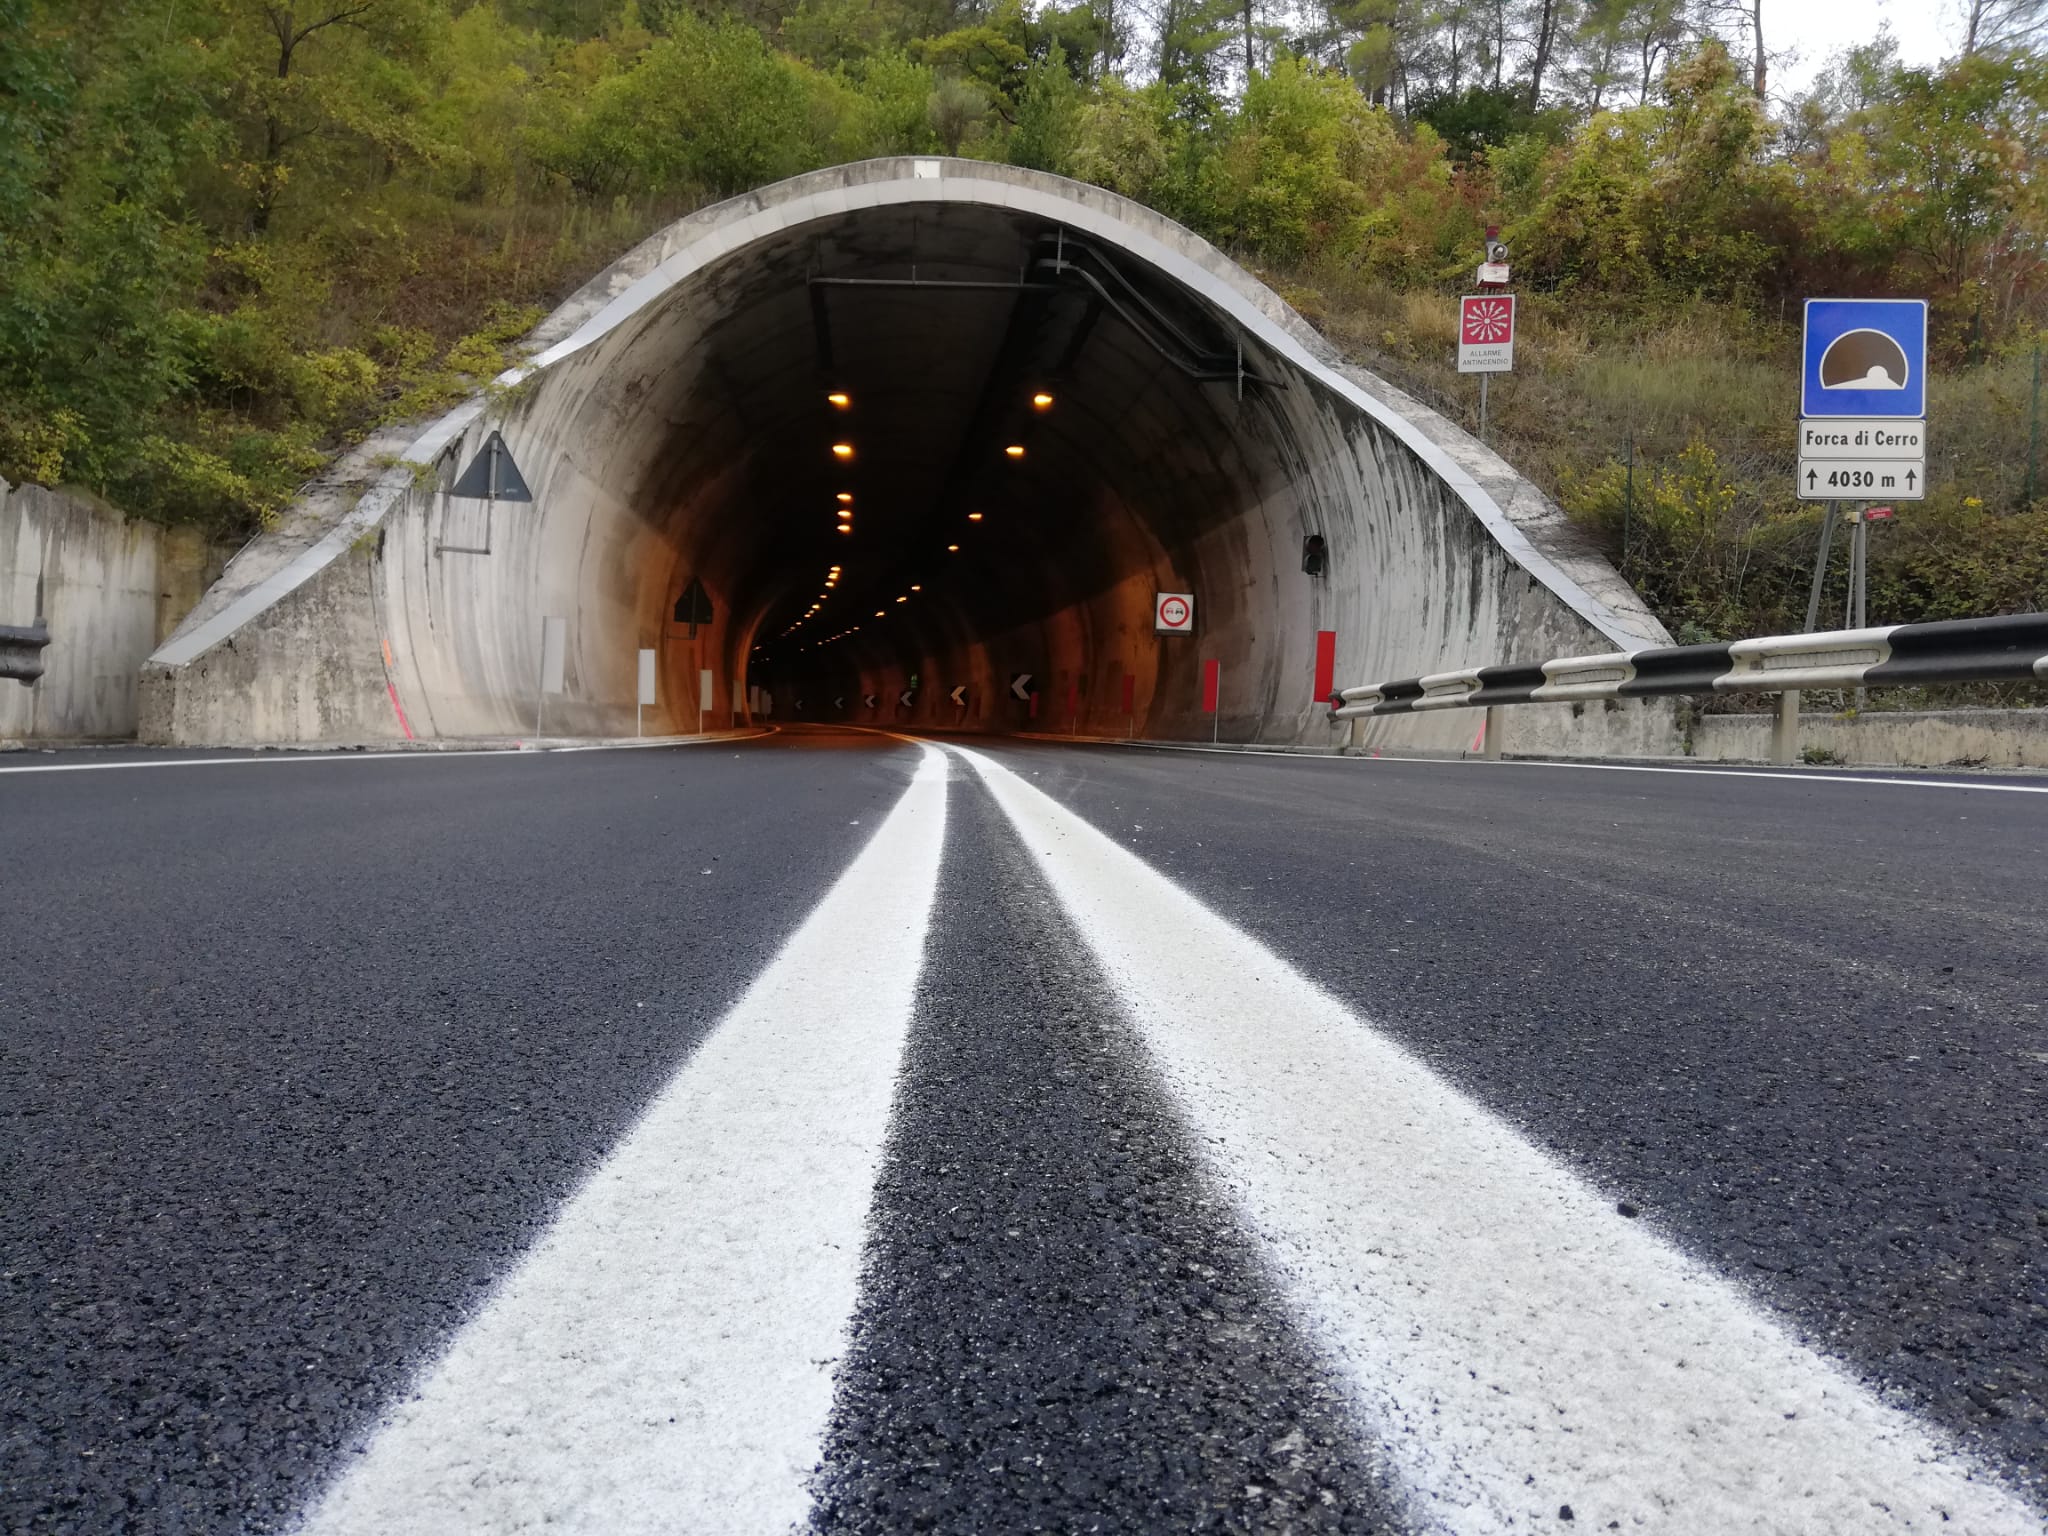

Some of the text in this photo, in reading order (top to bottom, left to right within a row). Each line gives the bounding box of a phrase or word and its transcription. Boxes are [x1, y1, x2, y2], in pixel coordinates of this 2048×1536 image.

[1462, 358, 1509, 366] ANTINCENDIO
[1806, 430, 1918, 446] Forca di Cerro
[1828, 471, 1895, 488] 4030 m
